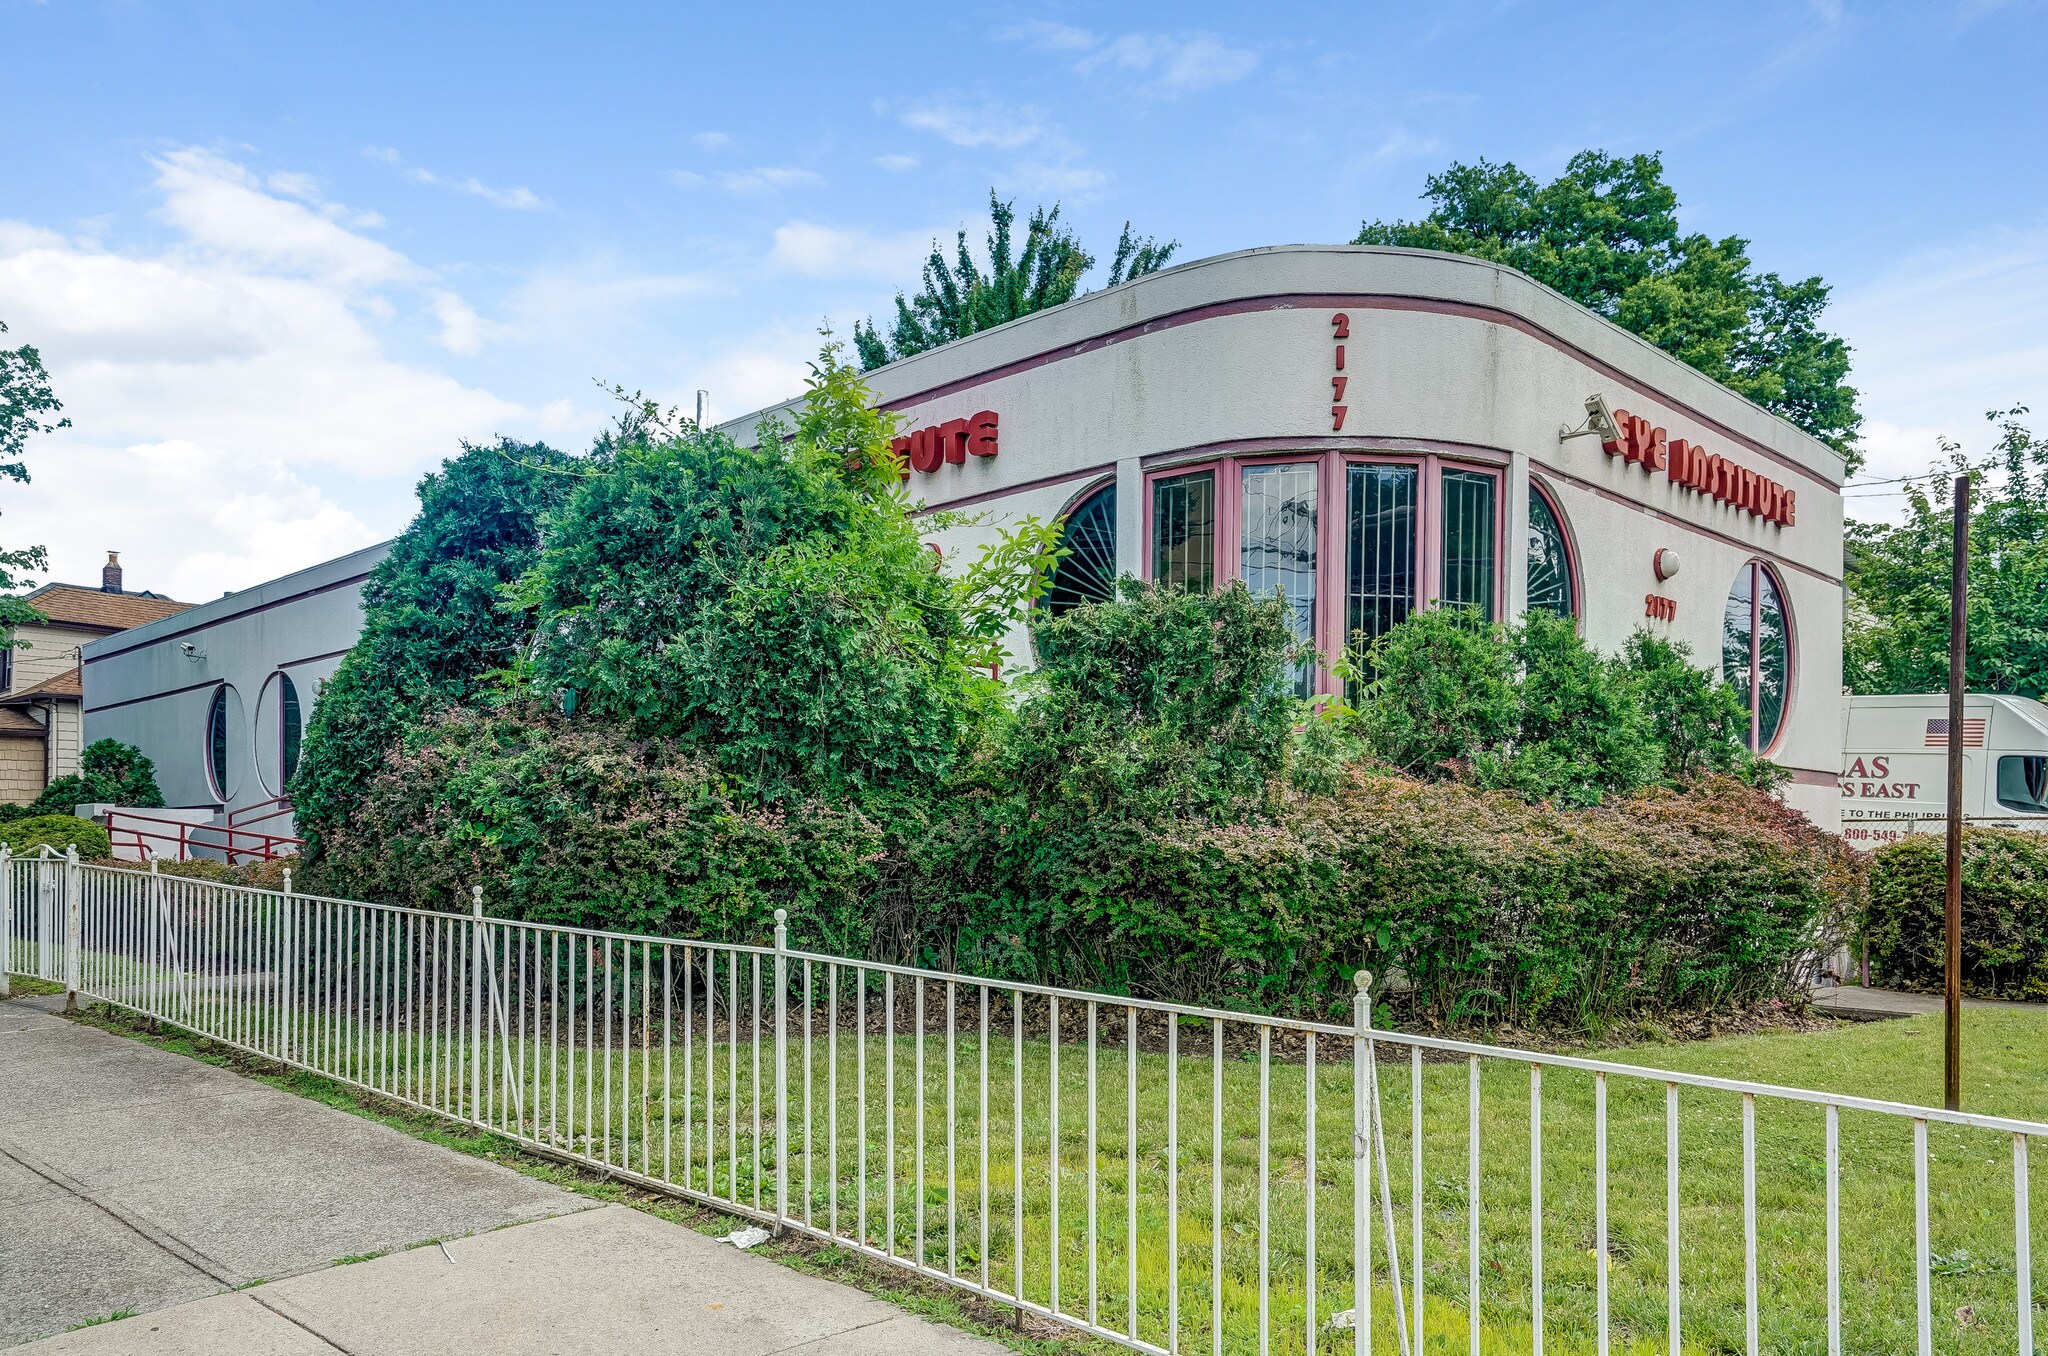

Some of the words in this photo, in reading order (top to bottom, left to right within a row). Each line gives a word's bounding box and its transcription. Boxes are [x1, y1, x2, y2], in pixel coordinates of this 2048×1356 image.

[1332, 313, 1349, 431] 2177
[872, 410, 998, 481] TUTE
[1668, 439, 1796, 528] INSTITUTE
[1645, 594, 1677, 623] 2177
[1838, 756, 1890, 779] AS
[1860, 782, 1921, 800] EAST
[1849, 809, 1864, 818] TO
[1868, 810, 1891, 819] THE
